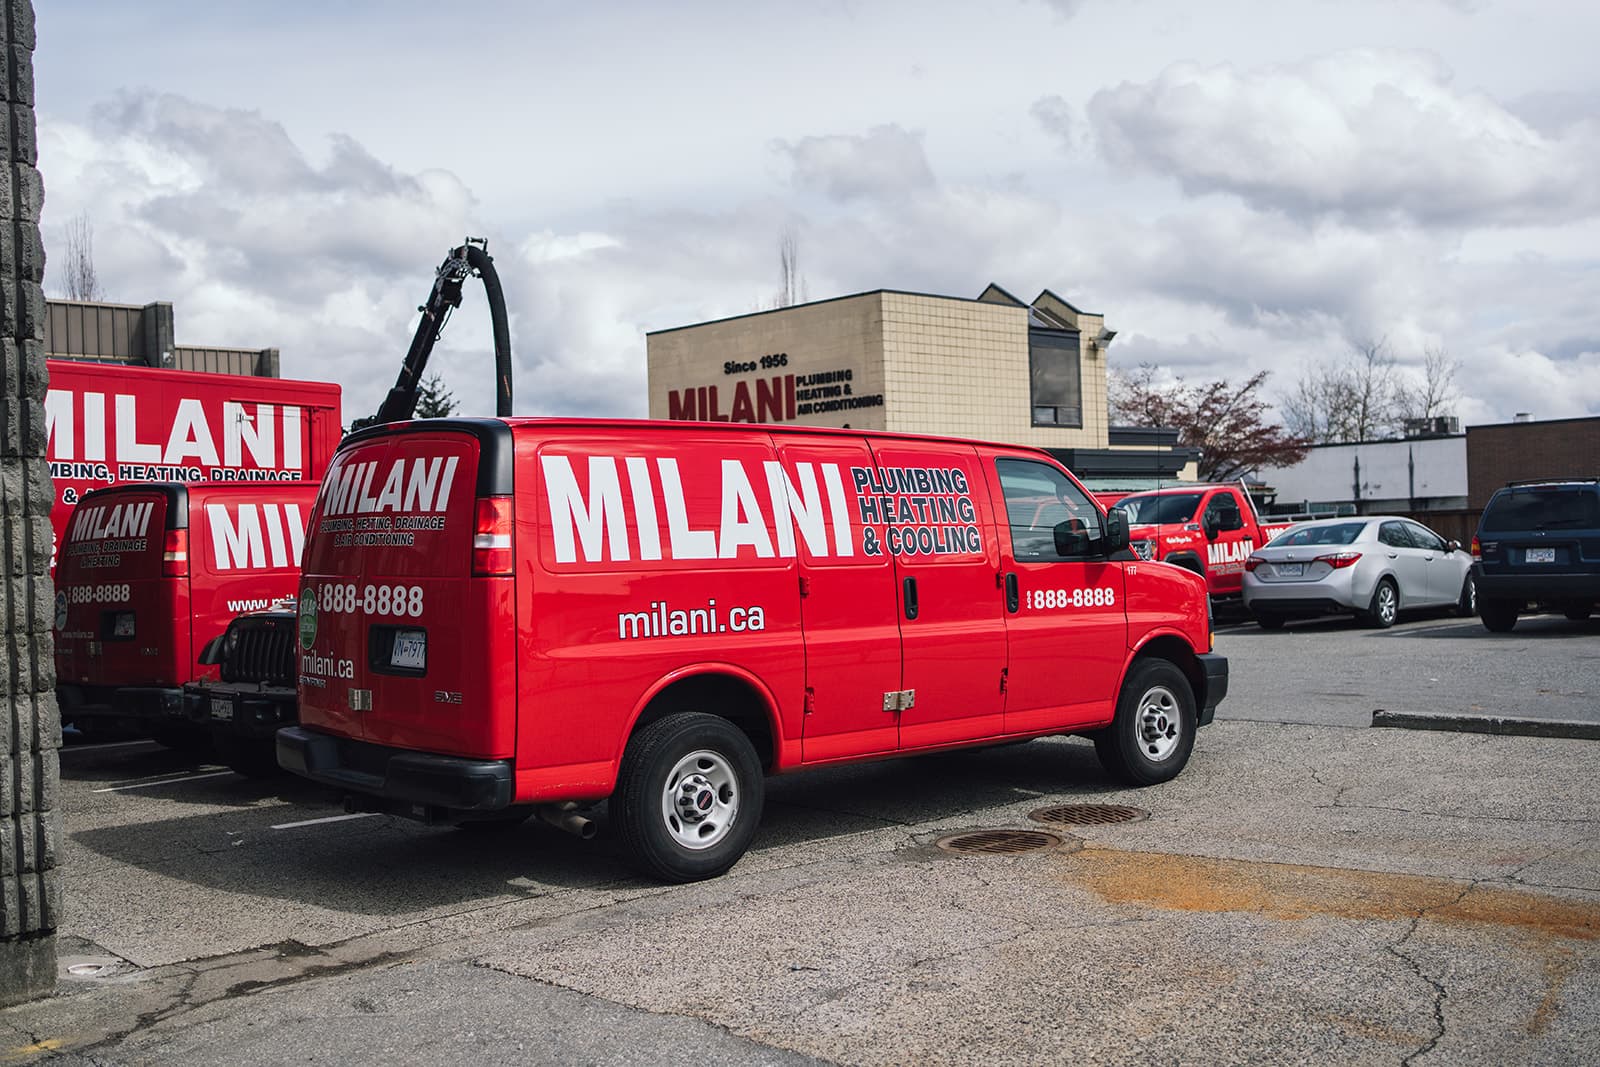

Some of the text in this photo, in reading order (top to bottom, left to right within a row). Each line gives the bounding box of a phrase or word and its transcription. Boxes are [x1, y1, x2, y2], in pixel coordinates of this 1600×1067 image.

[724, 353, 788, 375] Since 1956
[796, 369, 852, 387] PLUMBING
[668, 374, 796, 423] MILANI
[796, 384, 852, 401] HEATING &
[797, 394, 883, 415] AIR CONDITIONING
[211, 469, 302, 481] DRAINAGE
[322, 456, 460, 517] MILANI
[850, 466, 969, 495] PLUMBING
[71, 503, 154, 542] MILANI
[395, 515, 446, 531] DRAINAGE
[540, 455, 855, 564] MILANI
[859, 497, 977, 525] HEATING
[103, 539, 147, 552] DRAINAGE
[863, 525, 982, 557] & COOLING
[72, 584, 130, 603] 888-8888
[323, 583, 424, 617] 888-8888
[1034, 587, 1115, 609] 888-8888
[618, 599, 766, 640] milani.ca
[302, 650, 354, 679] milani.ca
